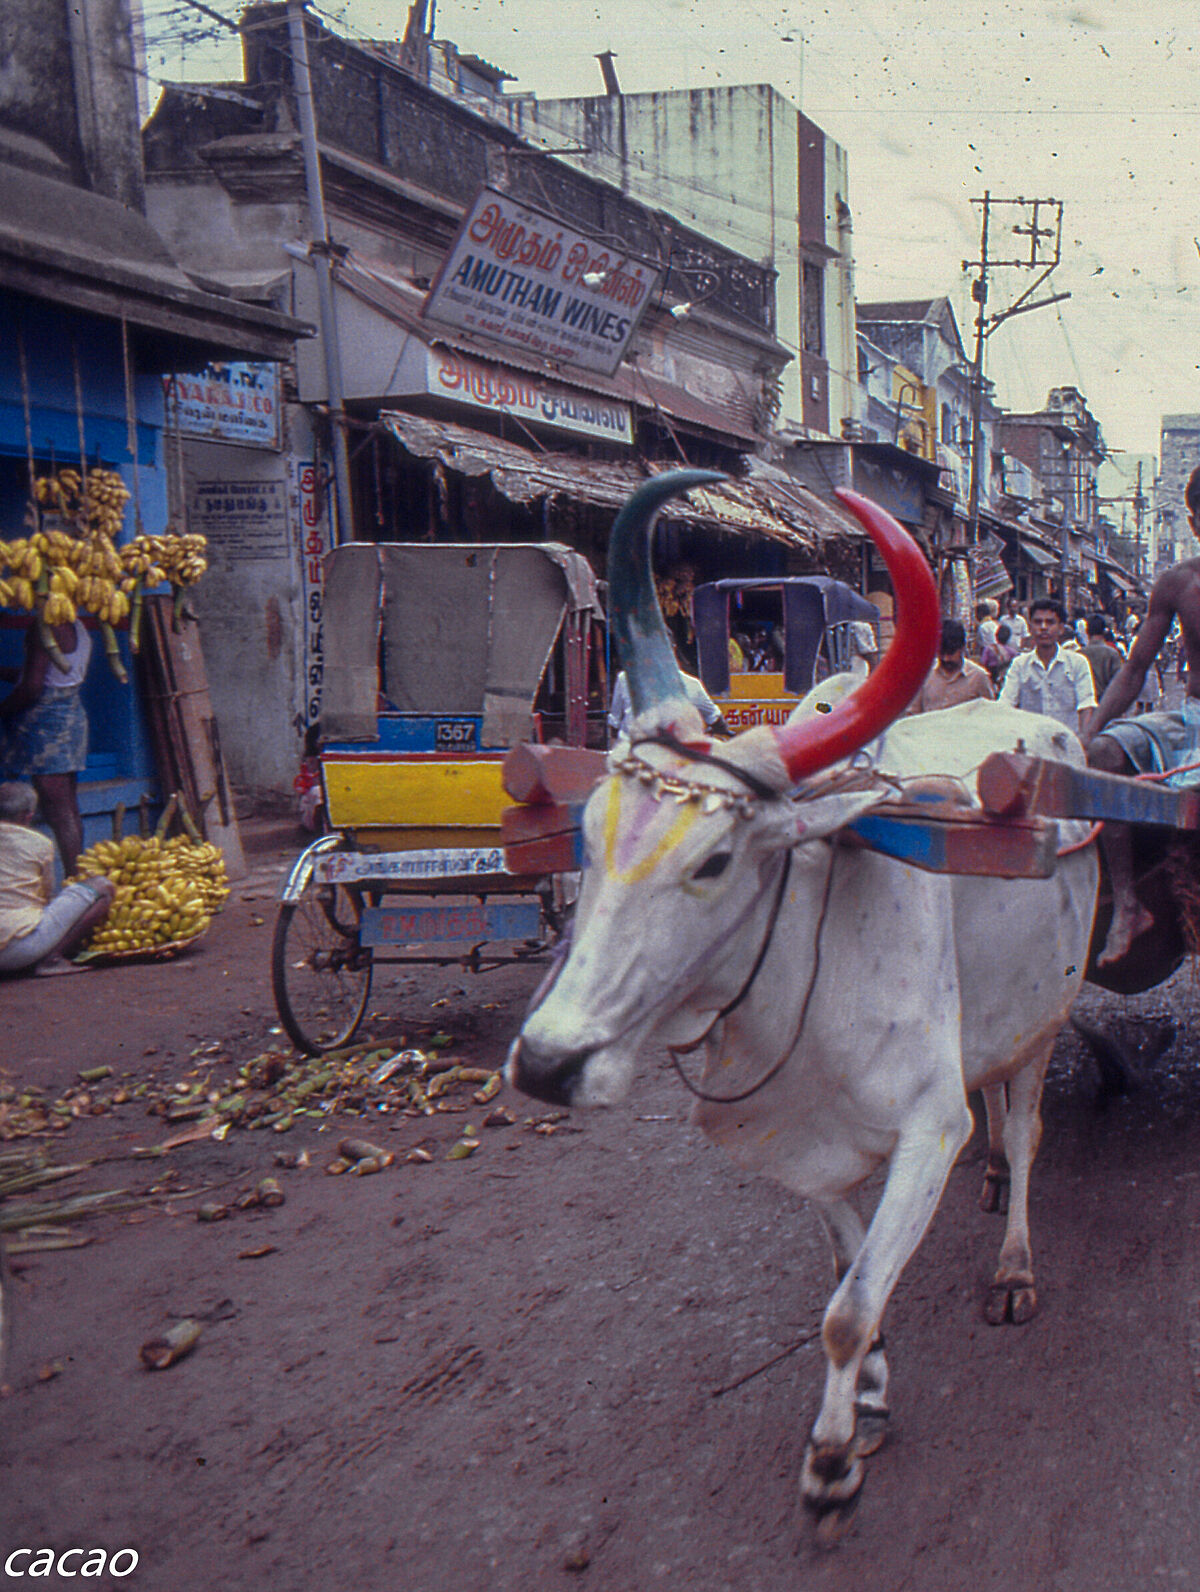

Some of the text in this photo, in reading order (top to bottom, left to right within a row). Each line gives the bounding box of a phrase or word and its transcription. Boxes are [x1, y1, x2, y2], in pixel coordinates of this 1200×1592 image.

[468, 203, 563, 271] அமுதம்
[452, 254, 563, 319] AMUTHAM
[561, 296, 632, 344] WINES
[437, 724, 475, 741] 1367
